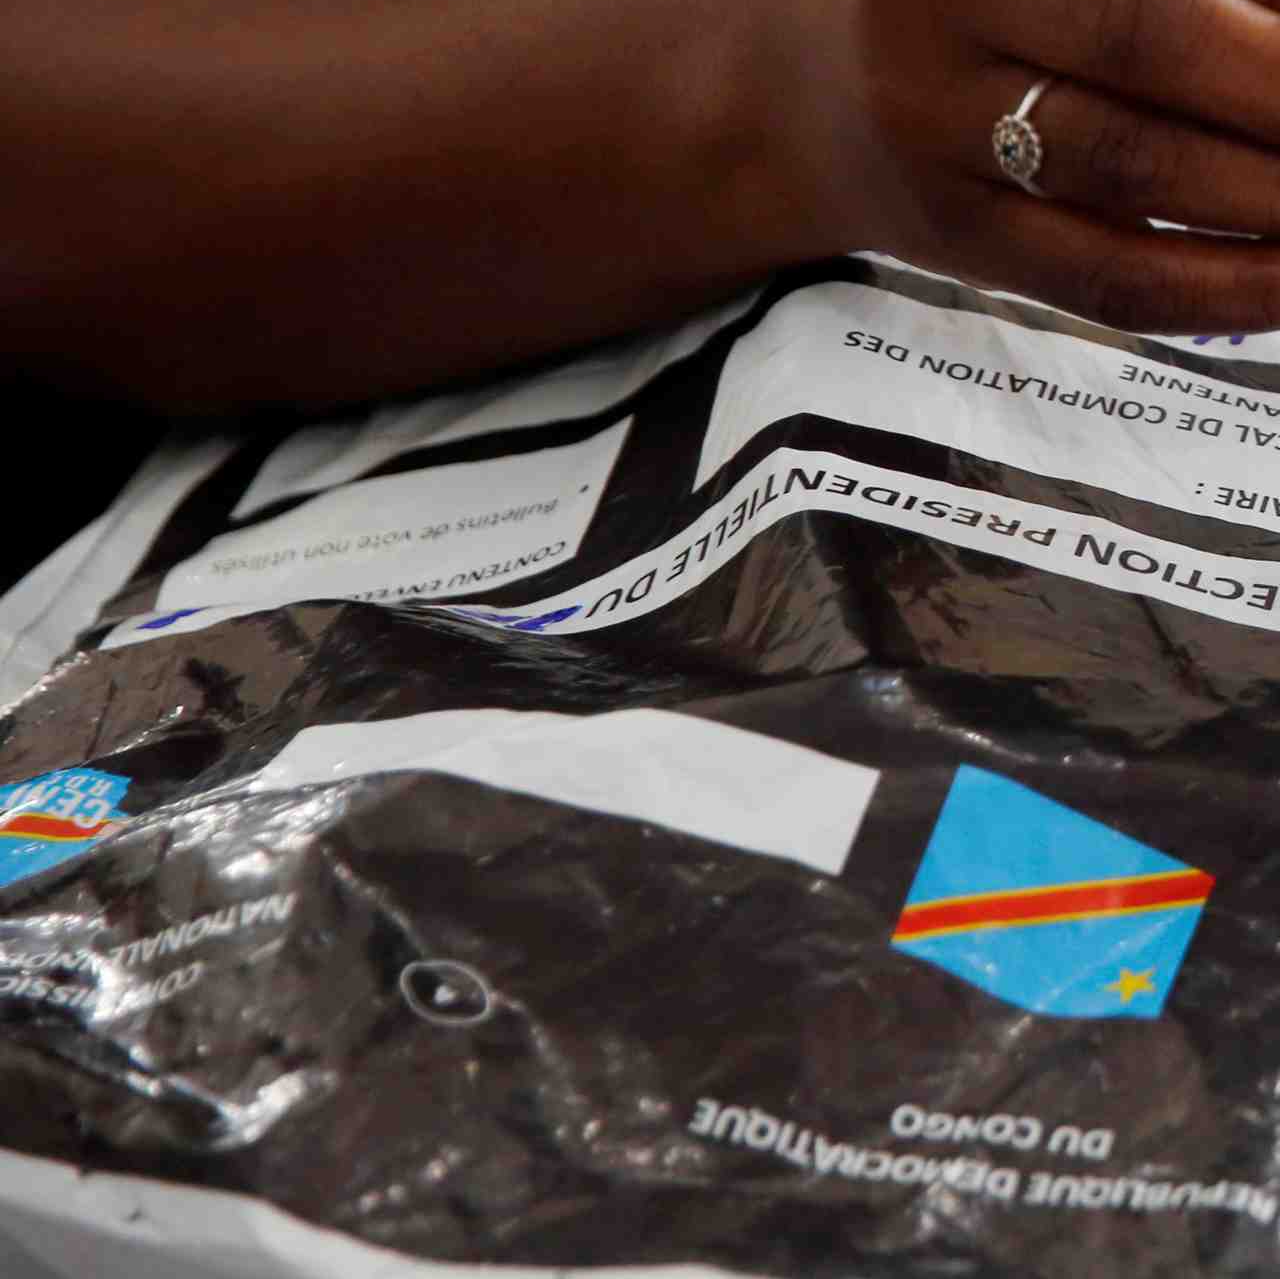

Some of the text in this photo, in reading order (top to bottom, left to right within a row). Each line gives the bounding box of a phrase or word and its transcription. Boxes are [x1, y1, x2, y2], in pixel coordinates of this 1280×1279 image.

[844, 330, 910, 363] DES
[919, 354, 1168, 425] COMPILATION
[1176, 411, 1225, 437] DE
[420, 523, 450, 541] de
[456, 498, 560, 532] Bulletins
[665, 467, 1057, 582] PRESIDENTIELLE
[303, 543, 352, 559] non
[356, 531, 413, 550] vote
[447, 540, 567, 589] CONTENU
[585, 567, 659, 618] DU
[888, 1102, 1116, 1162] DU CONGO
[687, 1096, 1280, 1224] REPUBLIQUE DEMOCRATIQUE
